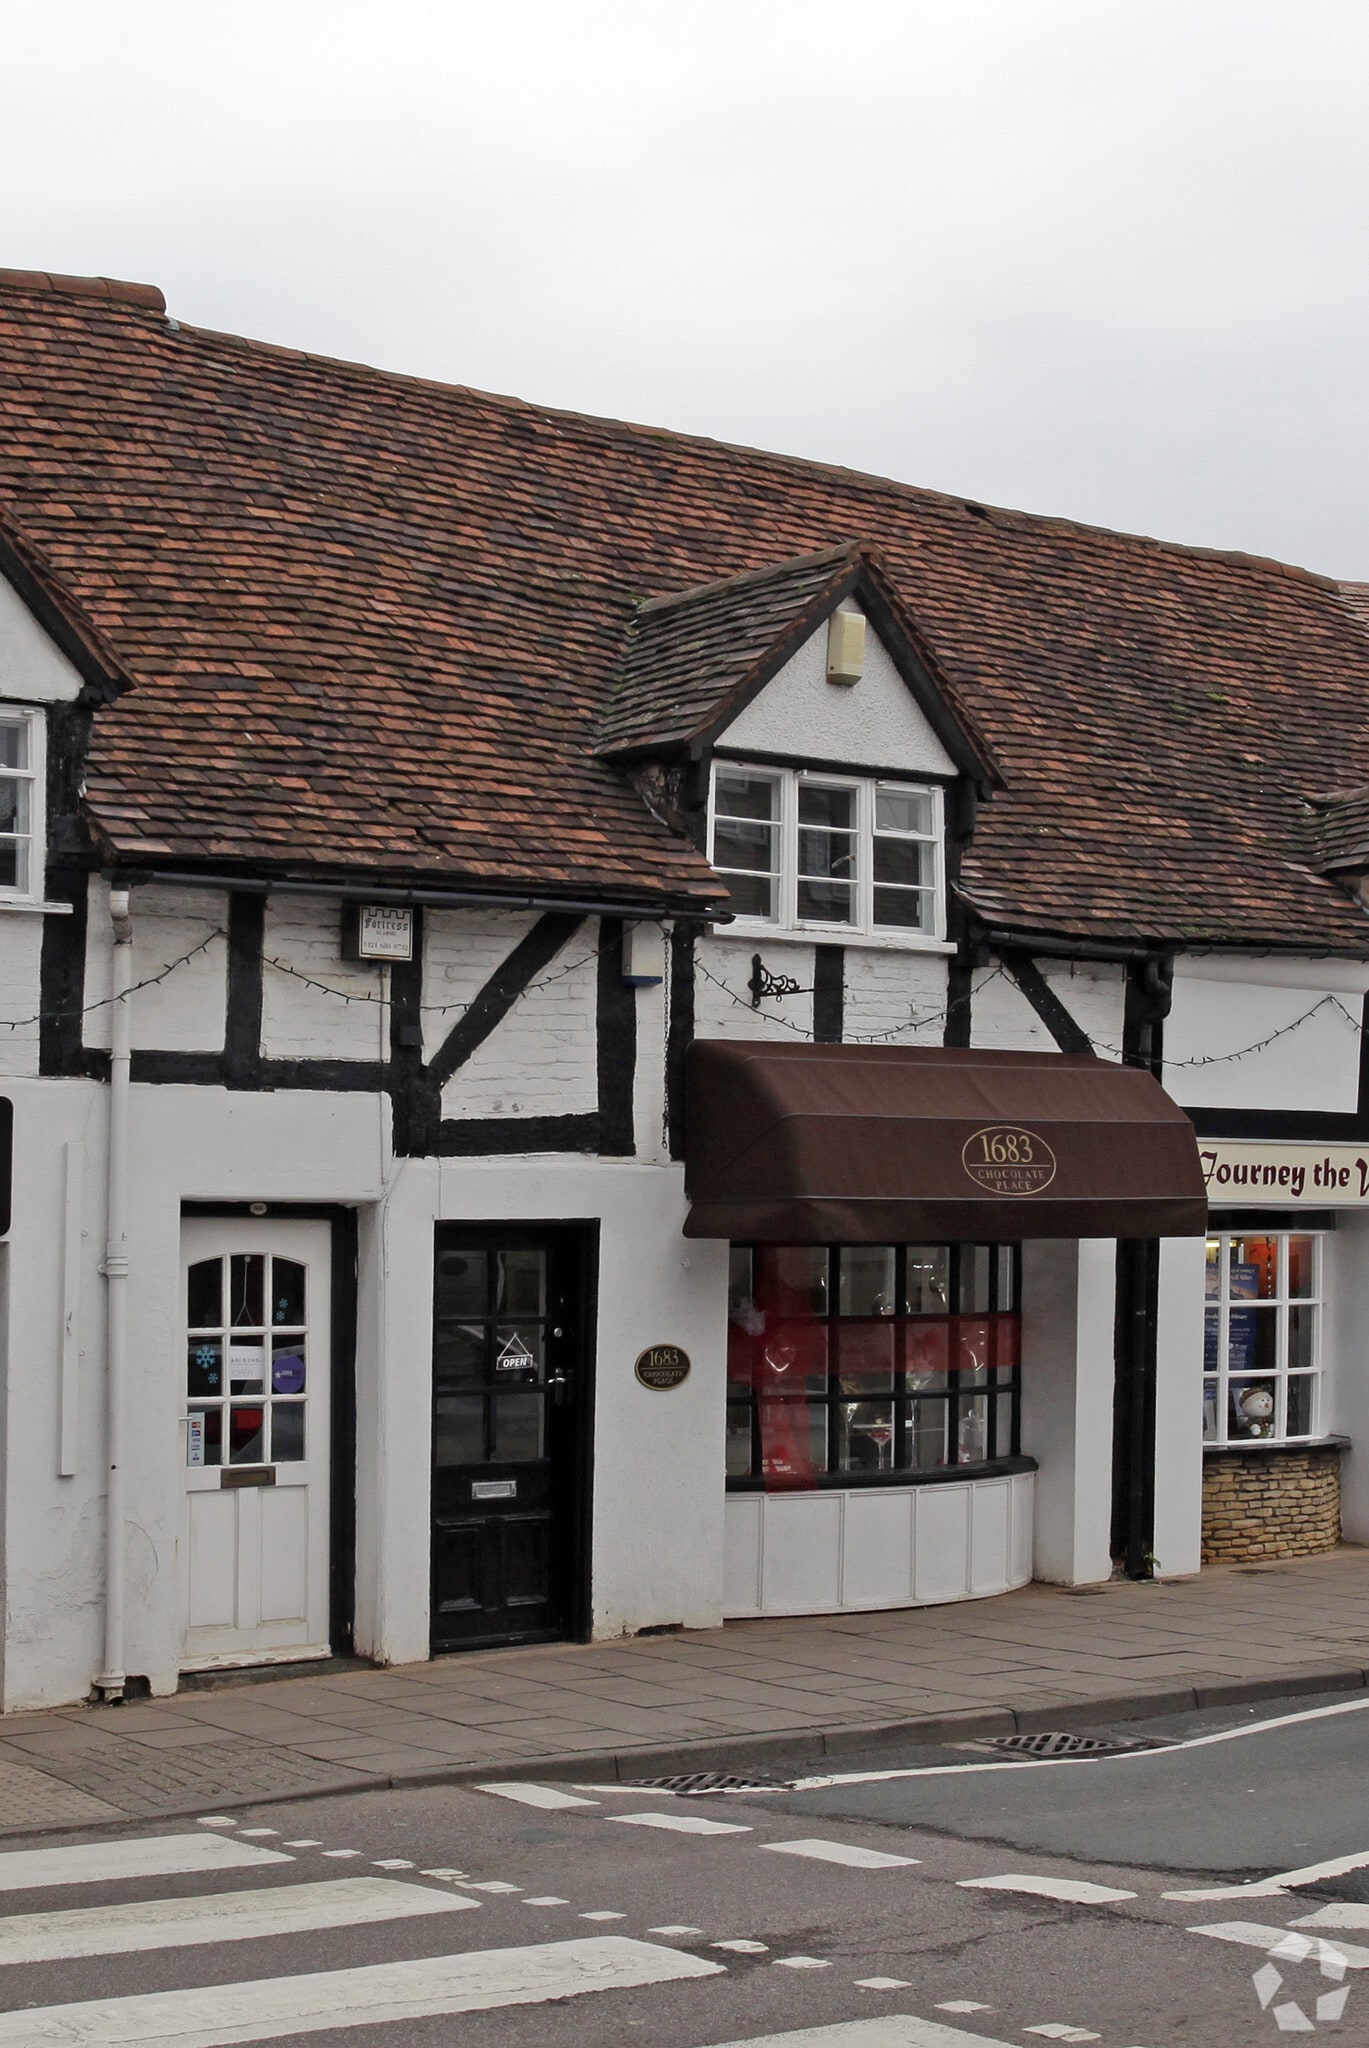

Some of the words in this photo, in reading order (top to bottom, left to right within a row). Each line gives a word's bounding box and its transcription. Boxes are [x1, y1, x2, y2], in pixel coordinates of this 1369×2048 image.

[364, 917, 409, 931] Fortress
[980, 1134, 1033, 1163] 1683
[977, 1169, 1046, 1179] CHOCOLATE
[1200, 1151, 1306, 1197] Journey
[1313, 1157, 1350, 1190] the
[995, 1180, 1033, 1190] PLACE
[502, 1357, 528, 1368] OPEN
[650, 1350, 679, 1366] 1683
